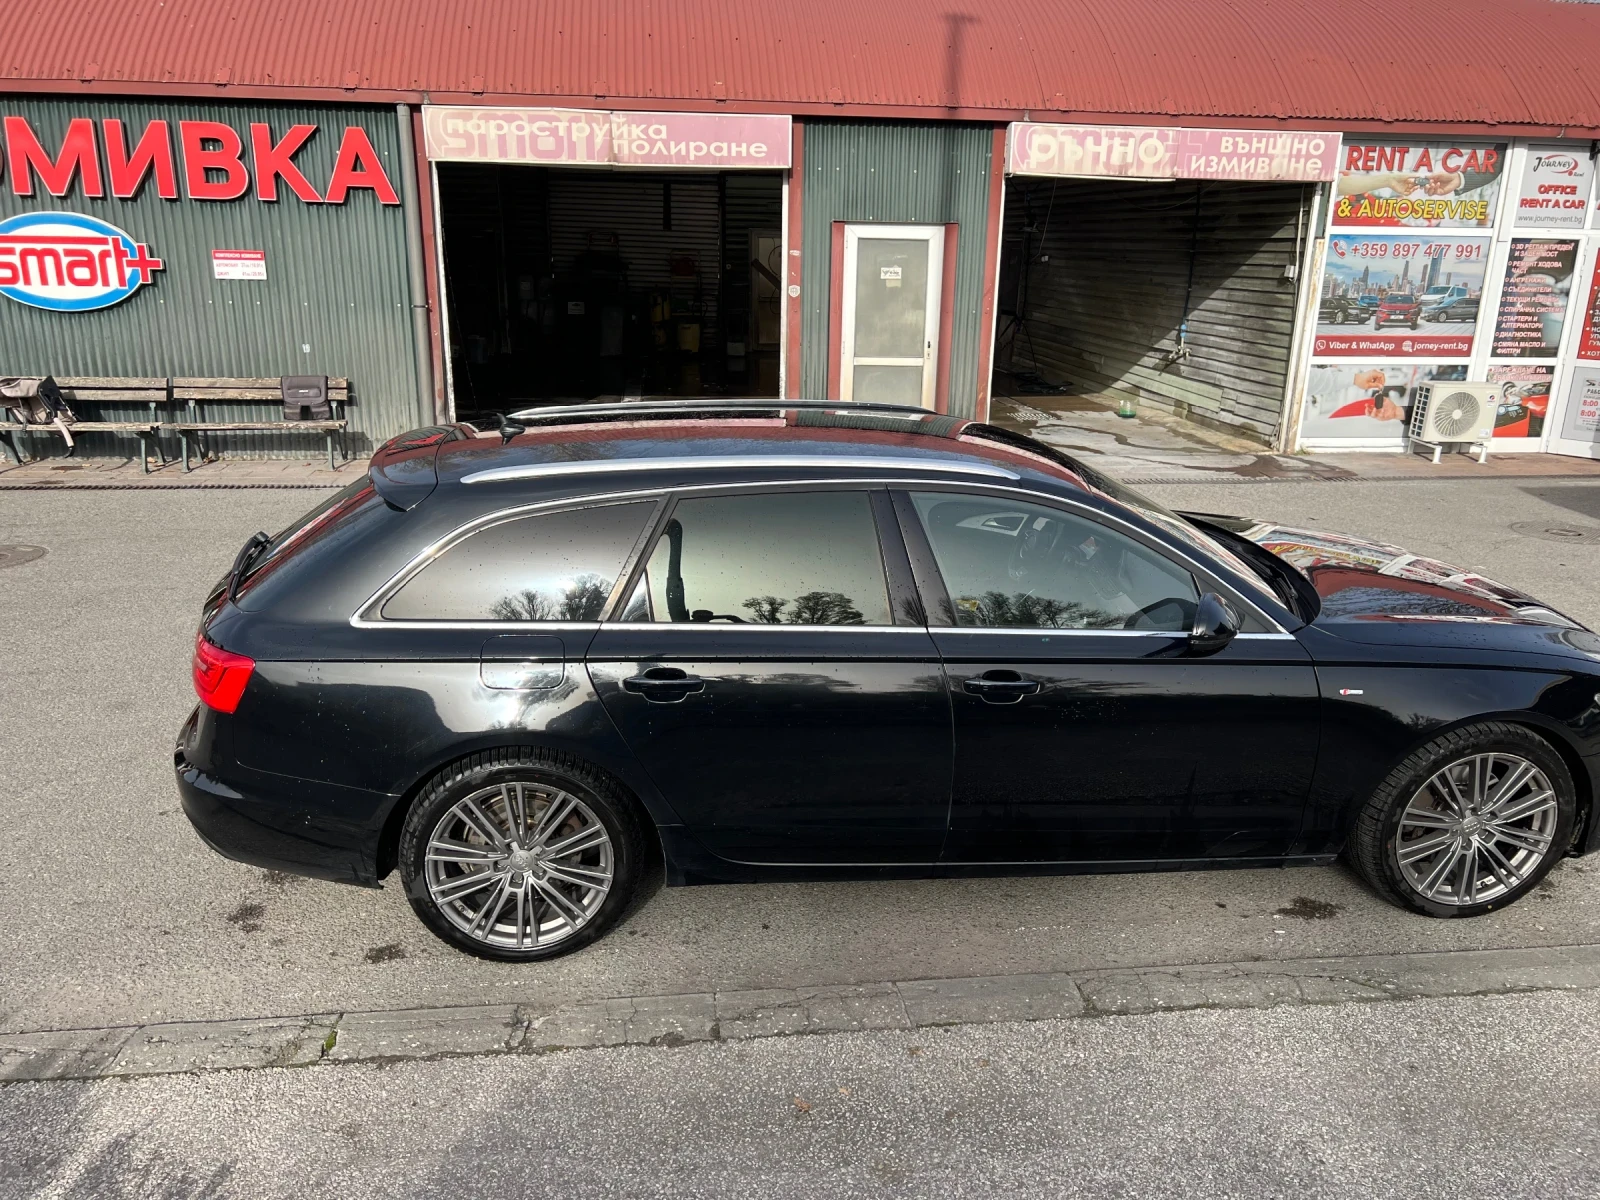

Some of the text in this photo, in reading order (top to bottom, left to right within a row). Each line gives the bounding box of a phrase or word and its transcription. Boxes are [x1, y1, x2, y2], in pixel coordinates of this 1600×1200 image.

[613, 139, 768, 161] полиране
[0, 116, 400, 205] МИВКА
[1345, 145, 1498, 173] RENT A CAR
[1538, 184, 1577, 195] OFFICE
[1337, 198, 1488, 220] & AUTOSERVISE
[1520, 198, 1552, 208] RENT
[1552, 199, 1560, 208] A
[1563, 199, 1585, 209] CAR
[1518, 215, 1583, 224] www.journey-rent.bg
[1351, 243, 1482, 258] +359 897 477 991
[1329, 341, 1349, 349] Viber
[1413, 342, 1468, 350] jorney-rent.bg
